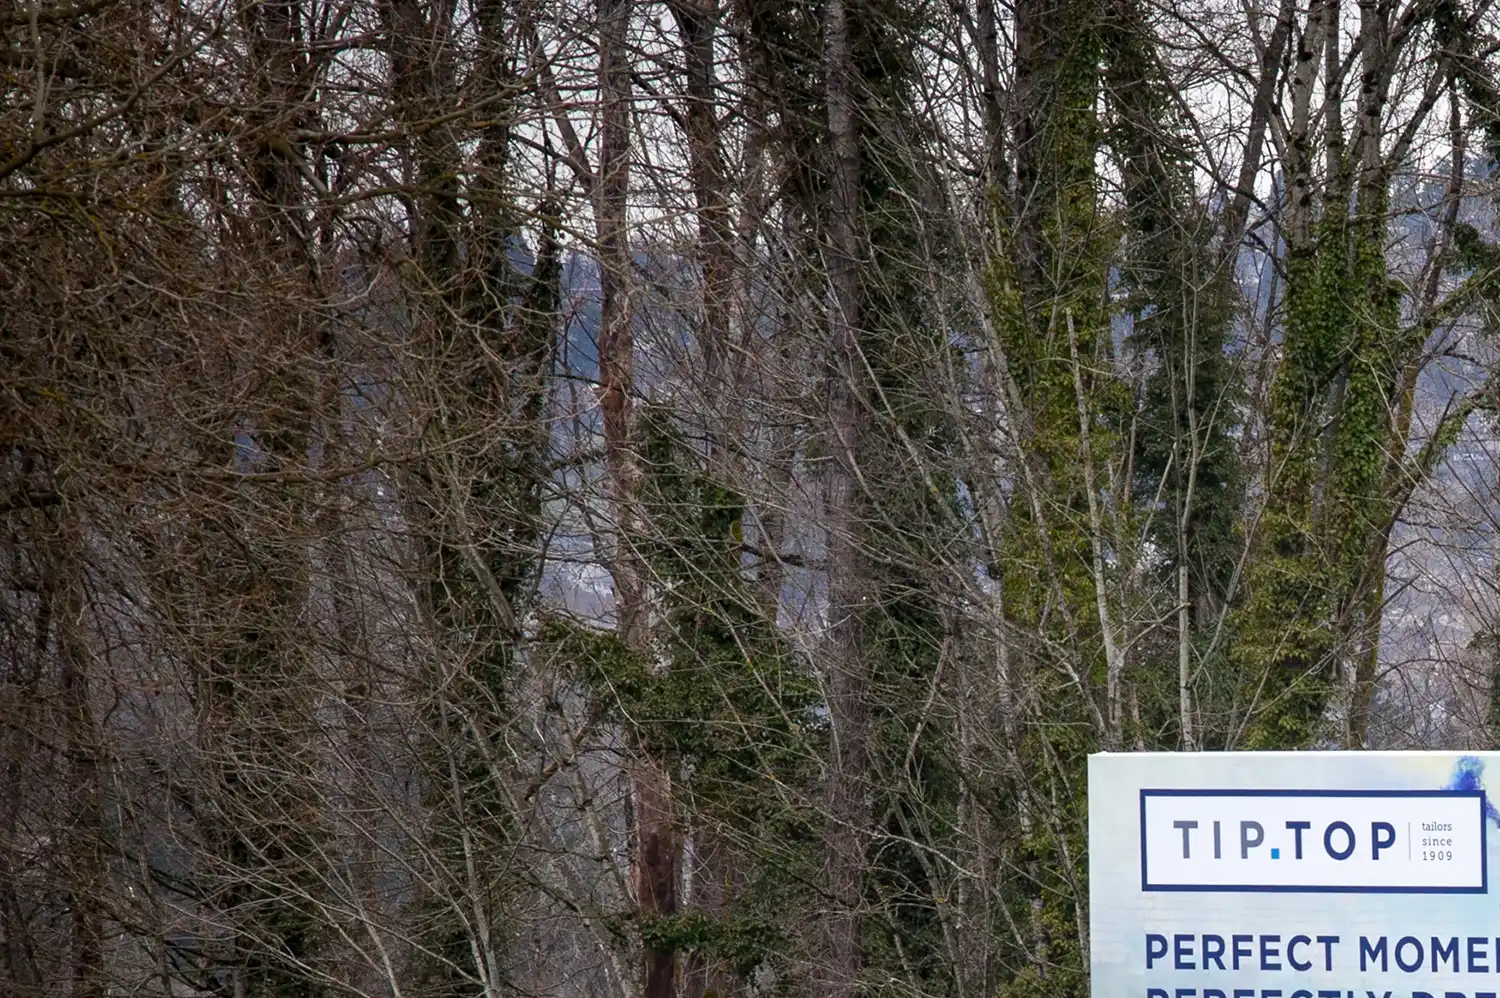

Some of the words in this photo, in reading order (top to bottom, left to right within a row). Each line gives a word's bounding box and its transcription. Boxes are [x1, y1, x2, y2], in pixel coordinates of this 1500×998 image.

[1421, 821, 1453, 832] tailors
[1173, 820, 1396, 861] TIP.TOP
[1422, 836, 1453, 847] since
[1422, 850, 1453, 861] 1909
[1145, 933, 1340, 973] PERFECT
